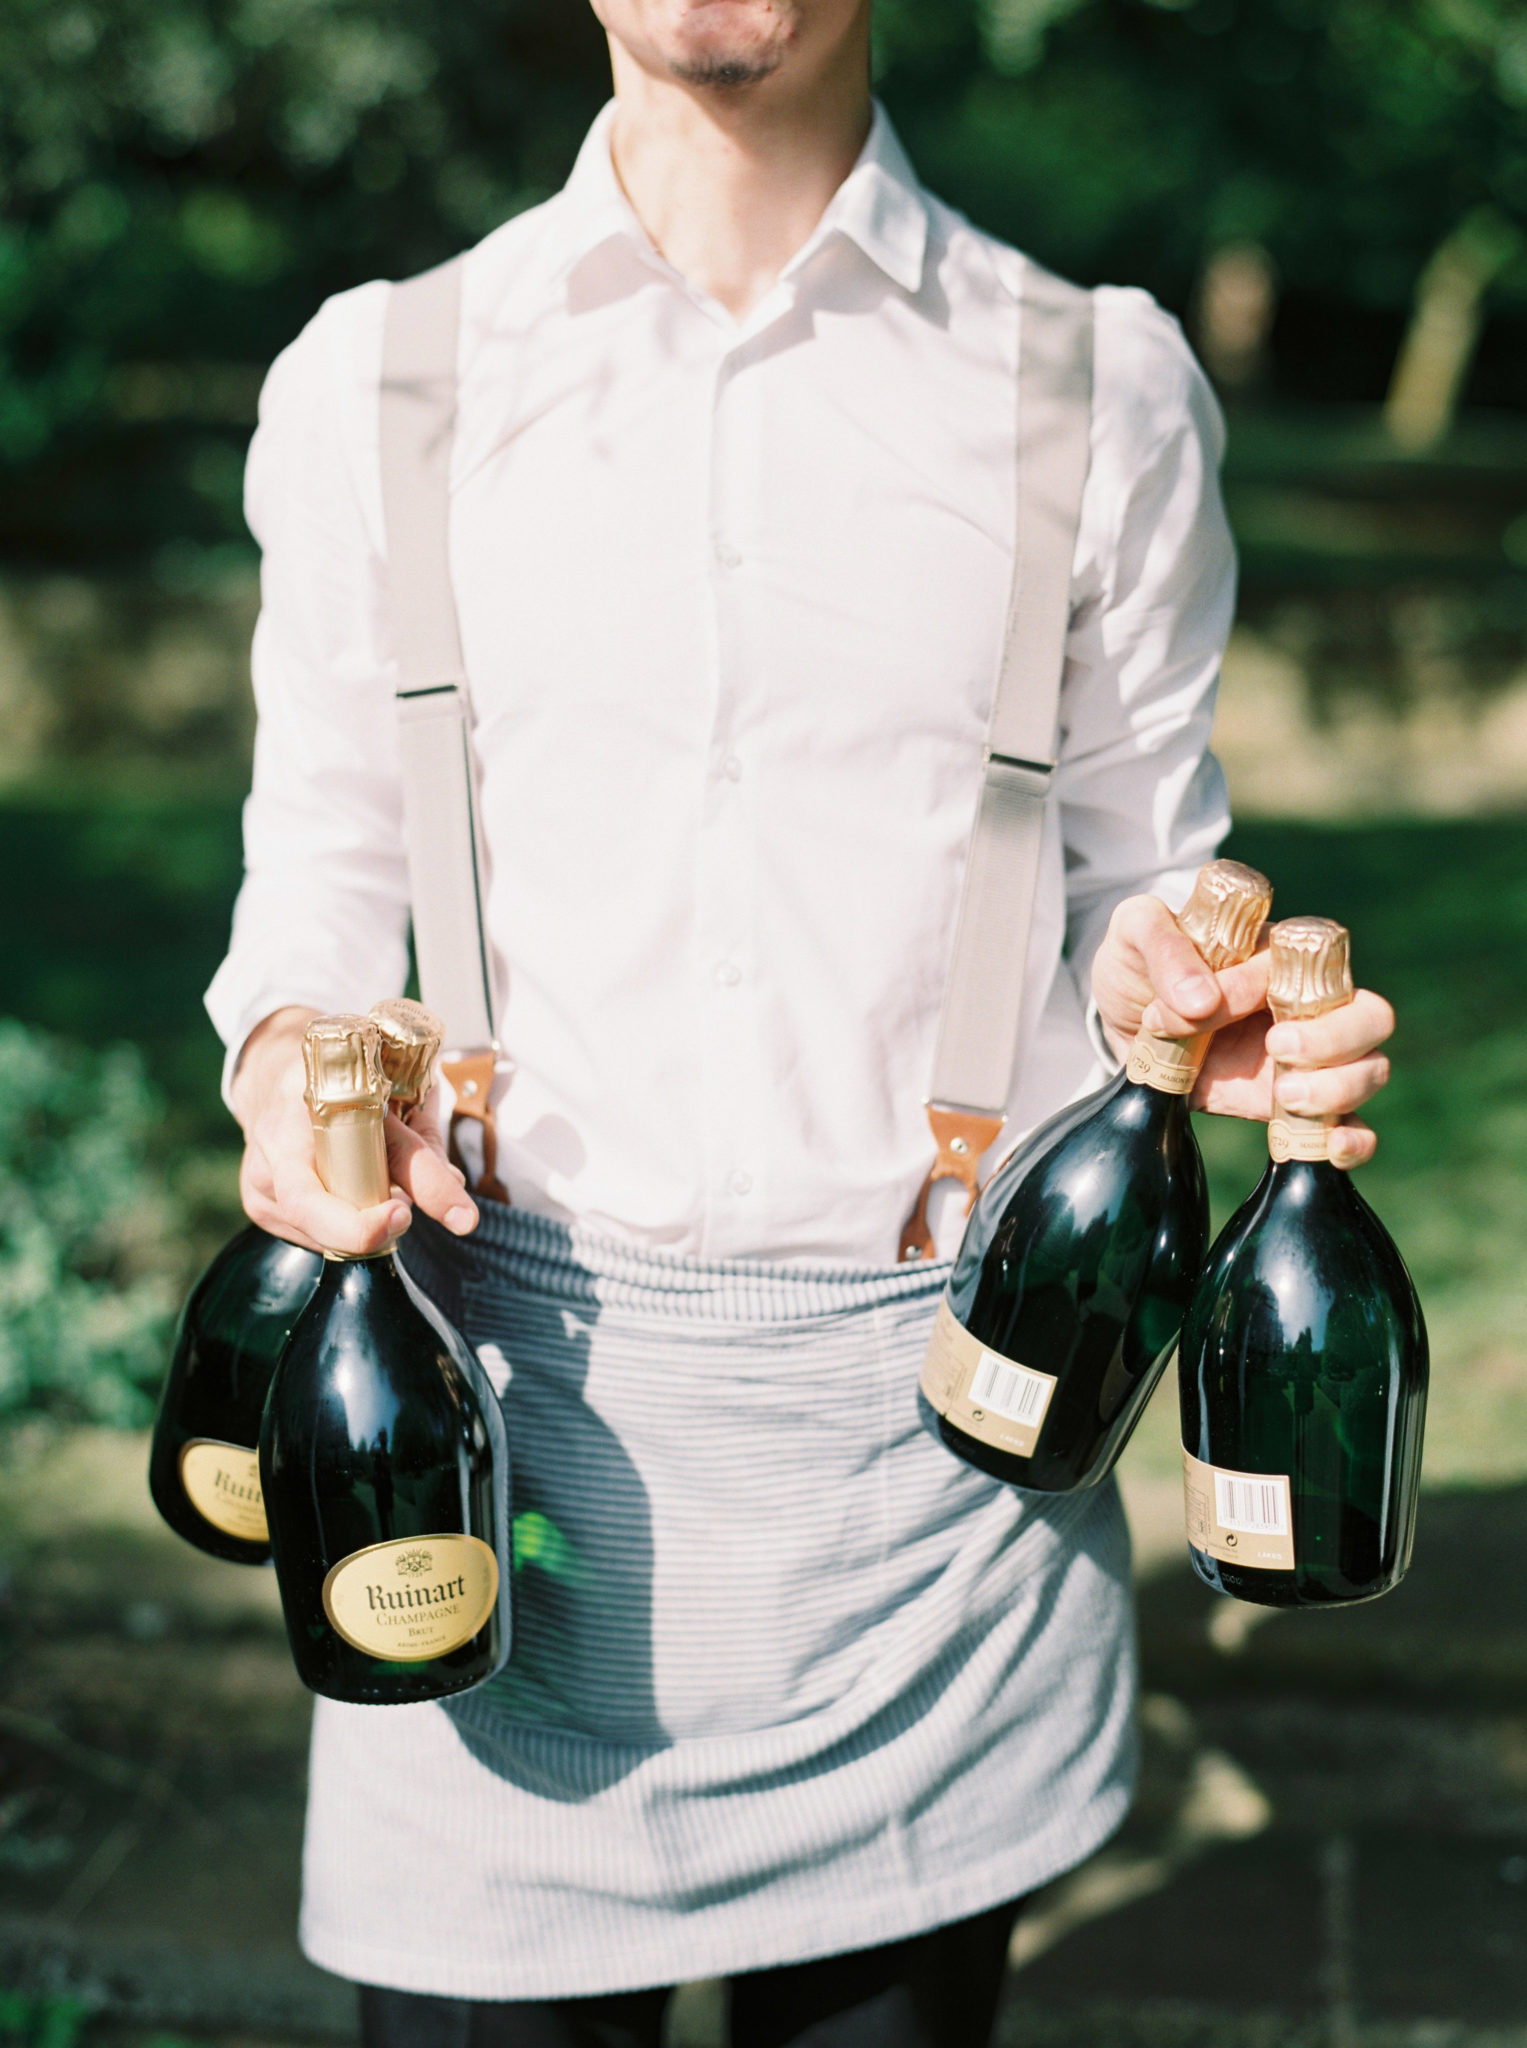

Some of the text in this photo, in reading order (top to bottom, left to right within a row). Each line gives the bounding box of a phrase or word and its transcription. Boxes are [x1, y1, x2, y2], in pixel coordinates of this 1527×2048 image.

[365, 1573, 465, 1611] Ruinart
[376, 1603, 461, 1626] CHAMPAGNE
[408, 1626, 434, 1637] BRUT
